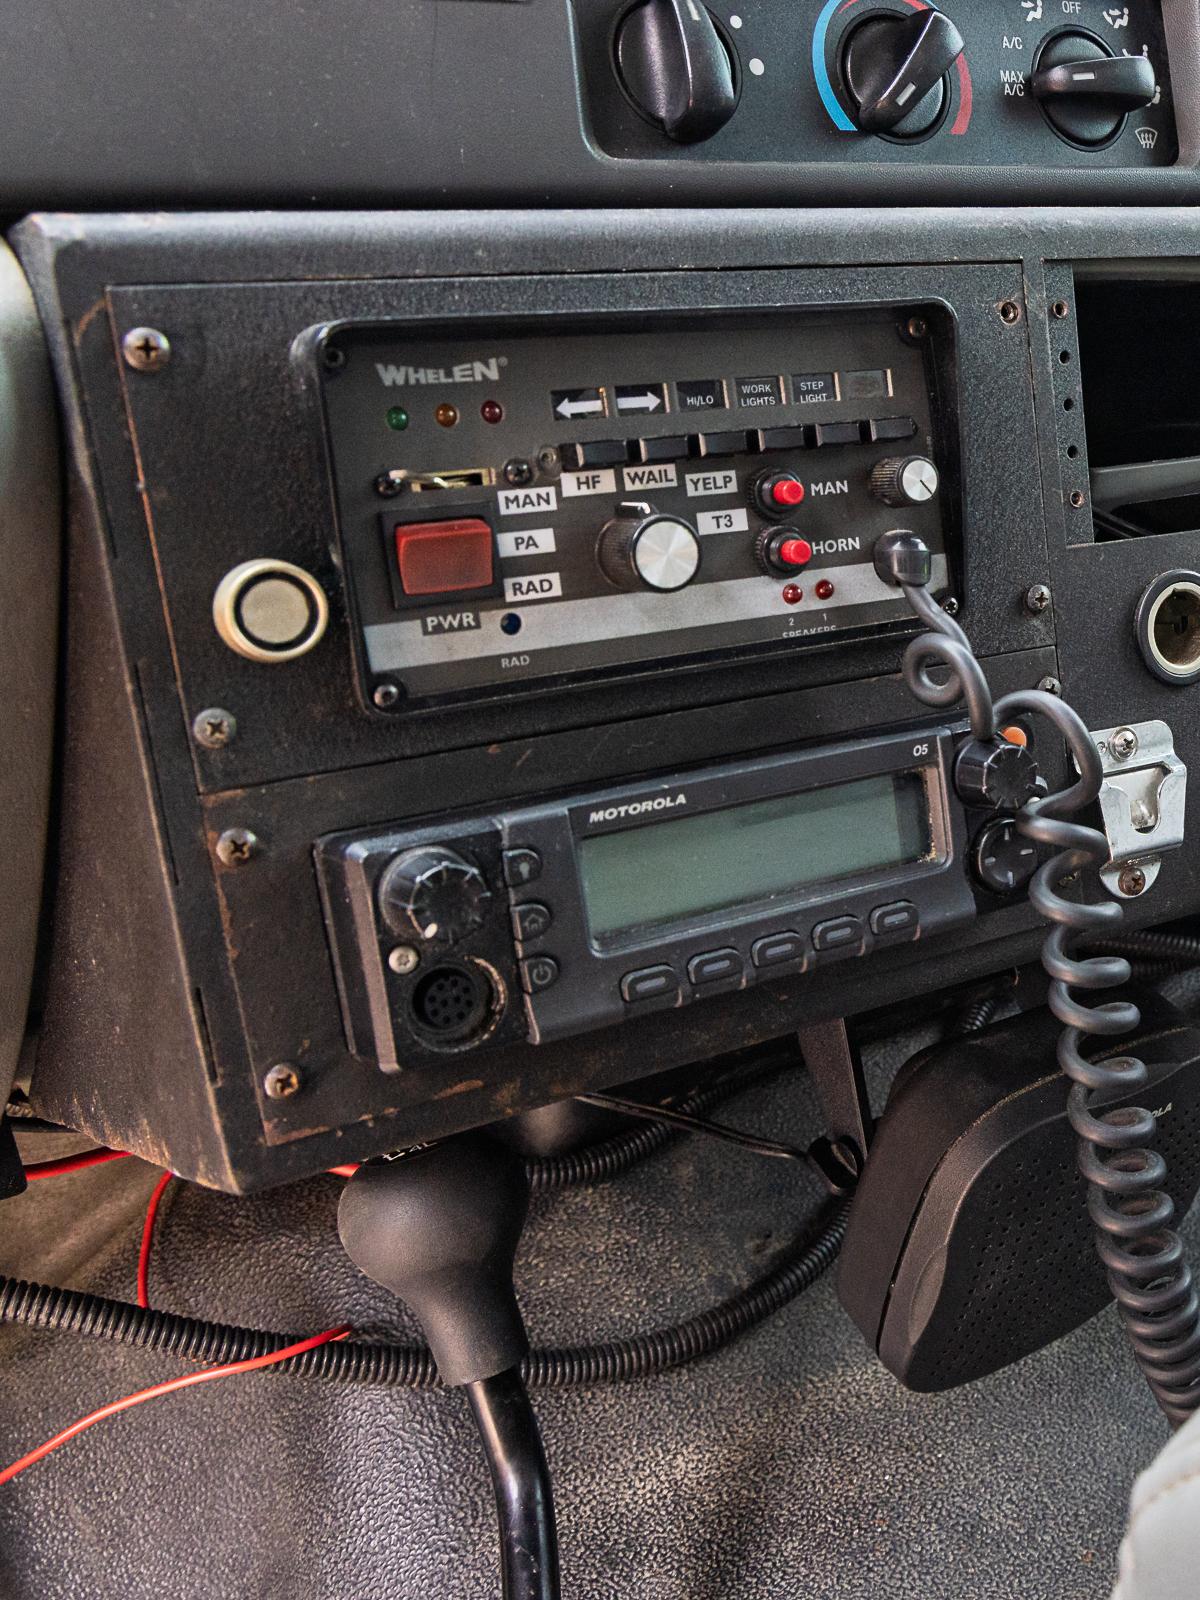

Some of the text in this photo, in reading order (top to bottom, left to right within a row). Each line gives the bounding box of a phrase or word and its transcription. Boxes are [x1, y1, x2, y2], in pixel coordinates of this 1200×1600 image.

[1061, 0, 1081, 14] OFF
[1002, 36, 1022, 49] A/C
[1000, 70, 1025, 84] MAX
[1004, 84, 1024, 97] A/C
[375, 357, 499, 387] WHELEN
[741, 383, 772, 394] WORK
[800, 381, 824, 391] STEP
[686, 395, 714, 407] HI/LO
[741, 396, 776, 407] LIGHTS
[800, 393, 828, 404] LIGHT
[575, 474, 602, 491] HF
[626, 466, 674, 486] WAIL
[690, 474, 733, 492] YELP
[810, 479, 849, 497] MAN
[503, 491, 551, 510] MAN
[711, 513, 734, 529] T3
[514, 535, 539, 551] PA
[811, 536, 860, 555] HORN
[511, 577, 553, 597] RAD
[425, 611, 477, 632] PWR
[788, 617, 795, 626] 2
[501, 654, 530, 669] RAD
[588, 793, 688, 824] MOTOROLA
